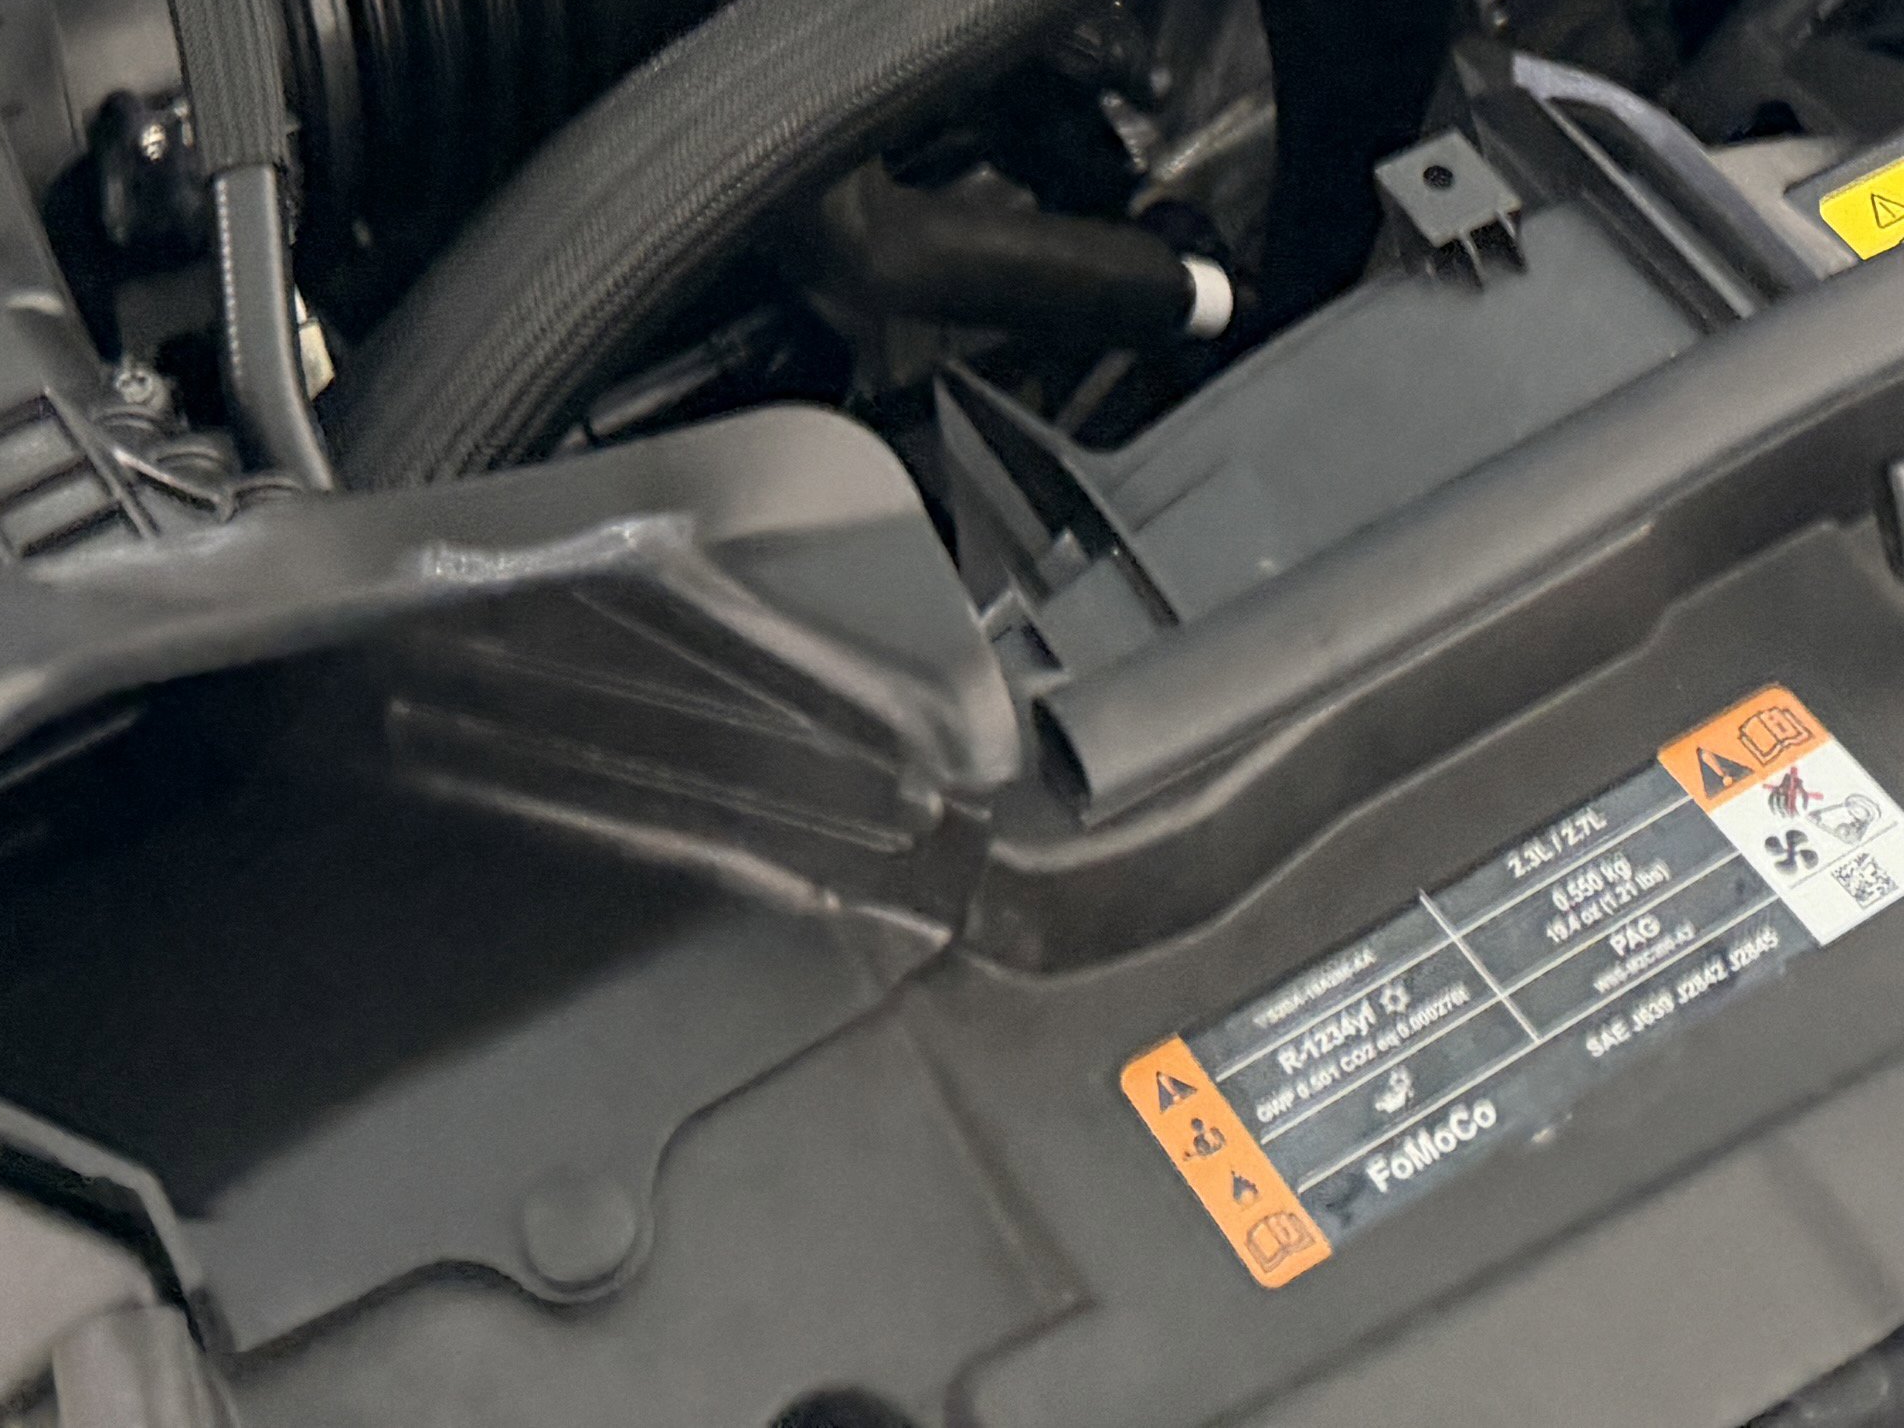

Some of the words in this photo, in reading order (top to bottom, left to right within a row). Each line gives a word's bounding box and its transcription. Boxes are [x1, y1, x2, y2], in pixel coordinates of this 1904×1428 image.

[1609, 912, 1661, 957] PAG
[1277, 998, 1377, 1074] R-1234yf
[1585, 1018, 1632, 1058] SAE
[1365, 1098, 1498, 1196] FoMoCo
